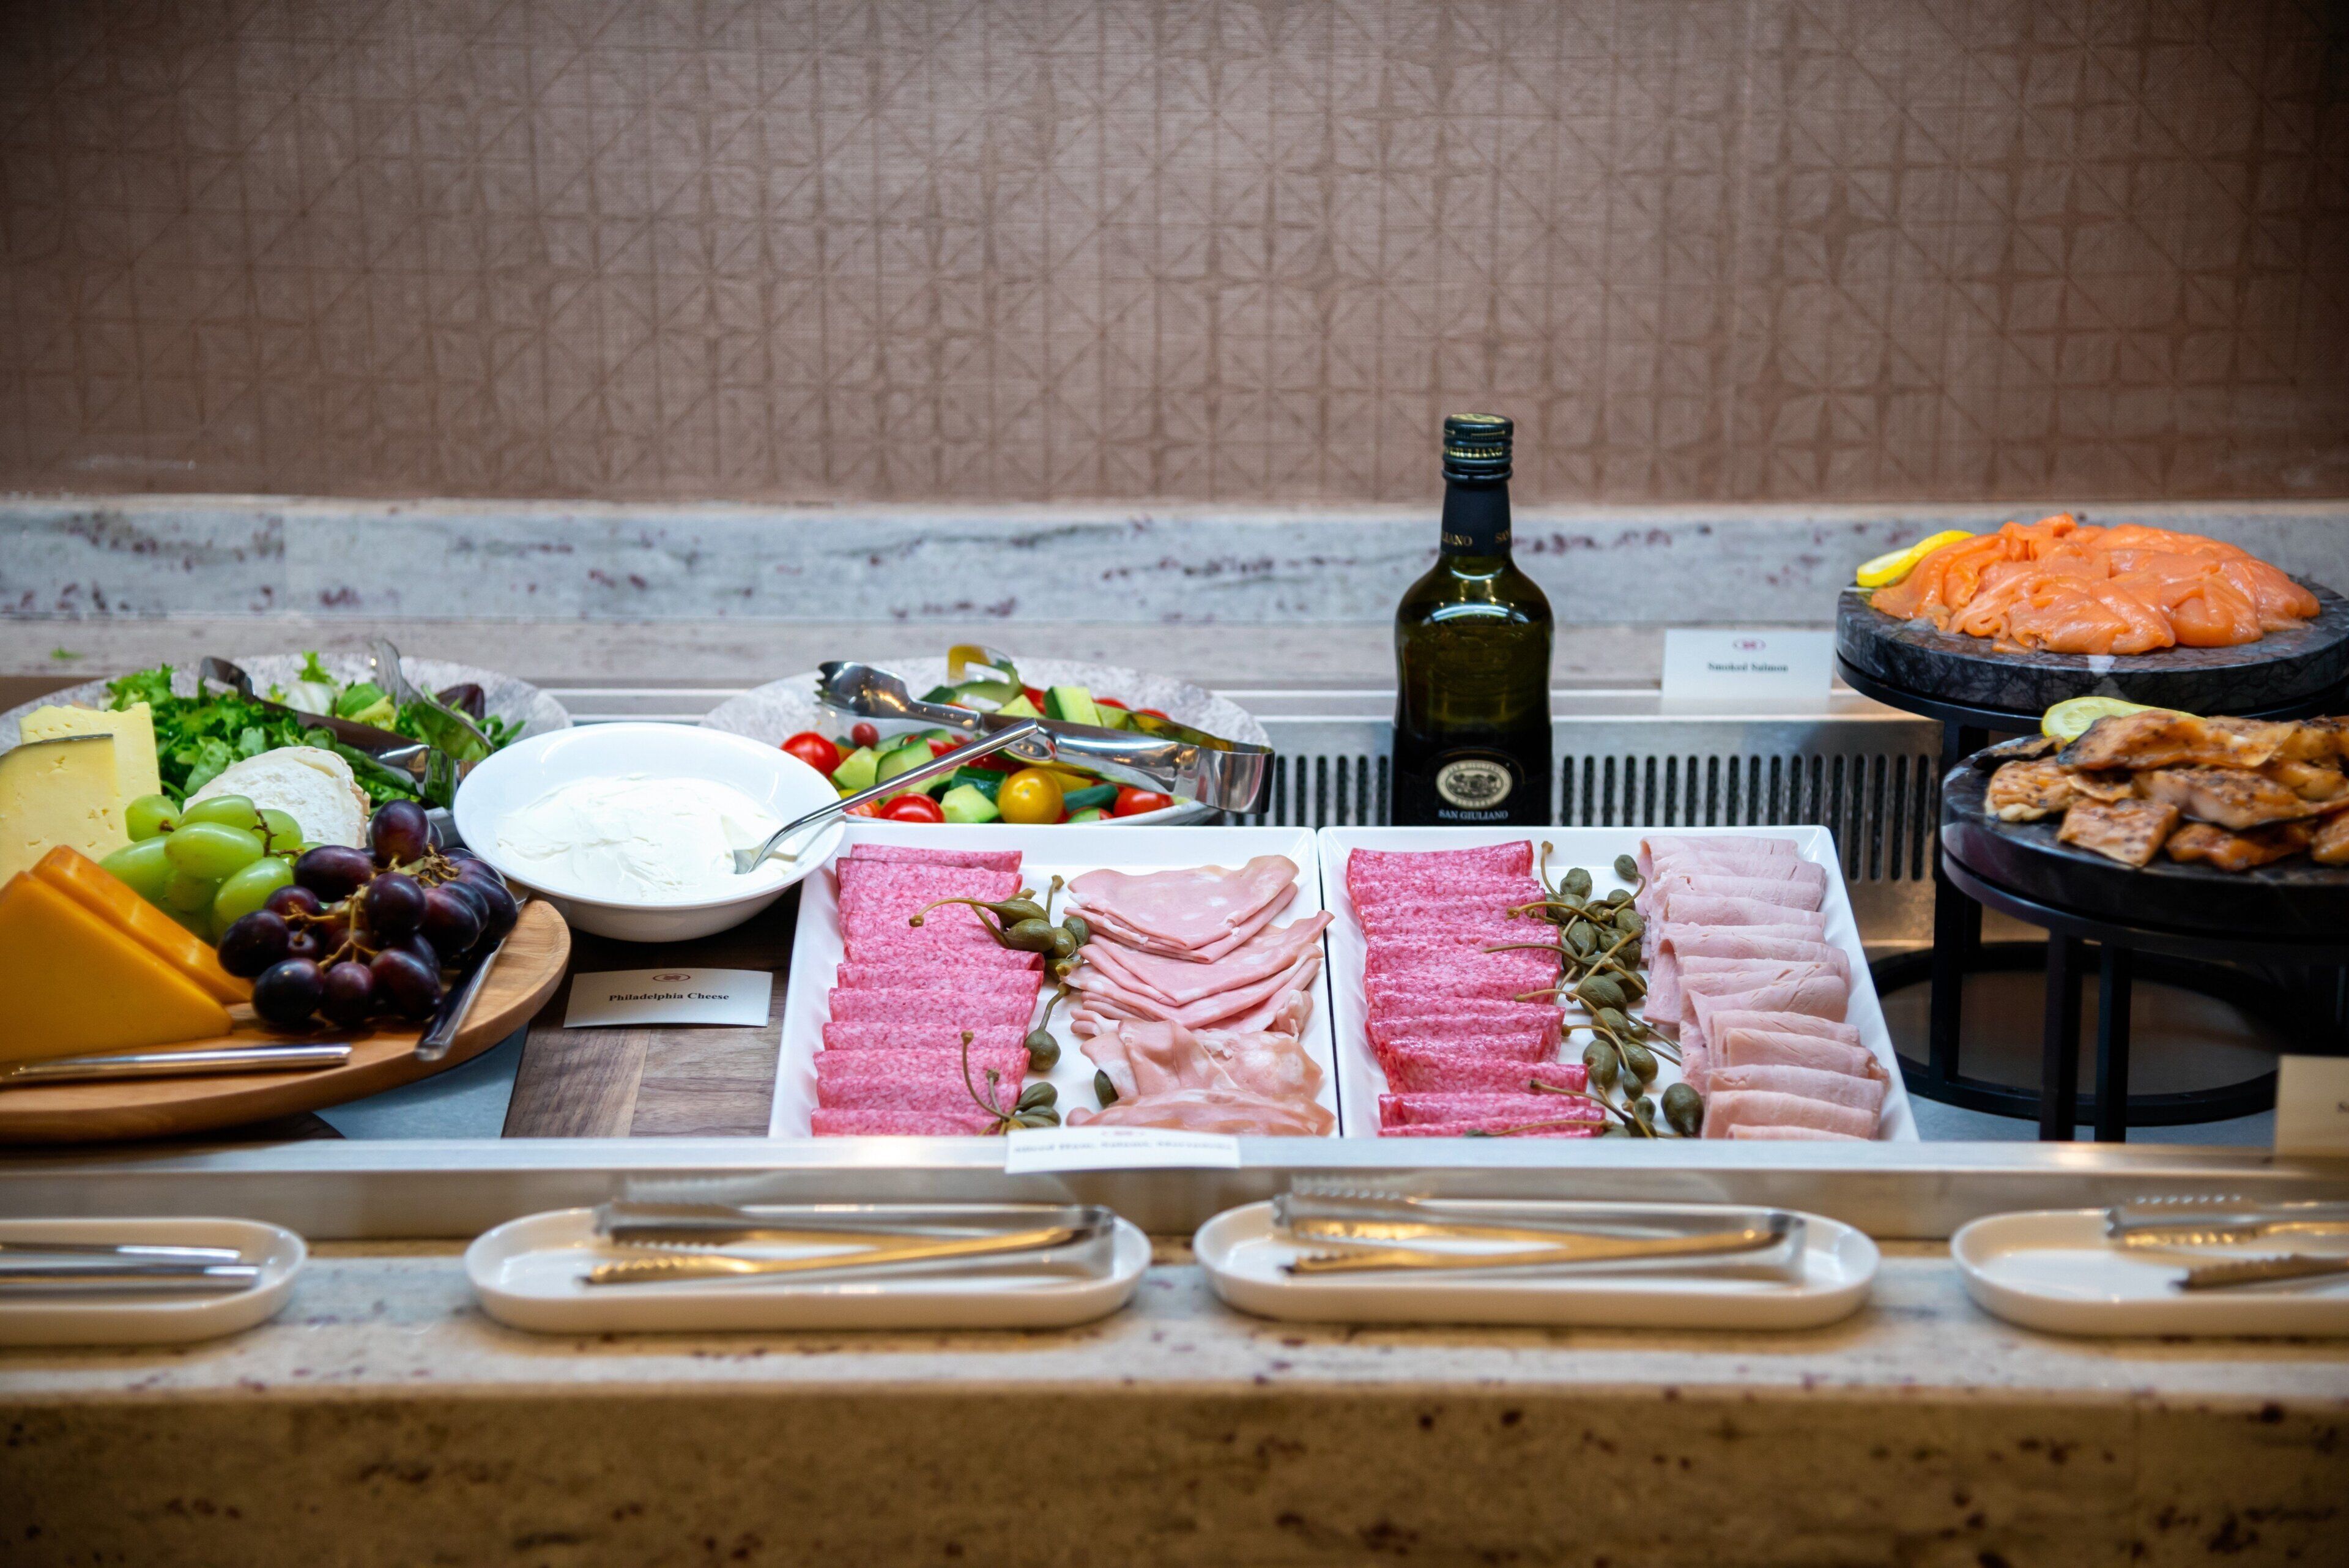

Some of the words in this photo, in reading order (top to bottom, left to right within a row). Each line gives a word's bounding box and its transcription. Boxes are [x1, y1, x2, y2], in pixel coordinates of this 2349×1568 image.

[1708, 662, 1748, 671] Smoked
[1751, 663, 1789, 672] Salmon
[1439, 809, 1458, 819] SAN
[1460, 810, 1508, 820] GIULIANO
[609, 992, 683, 1001] Philadelphia
